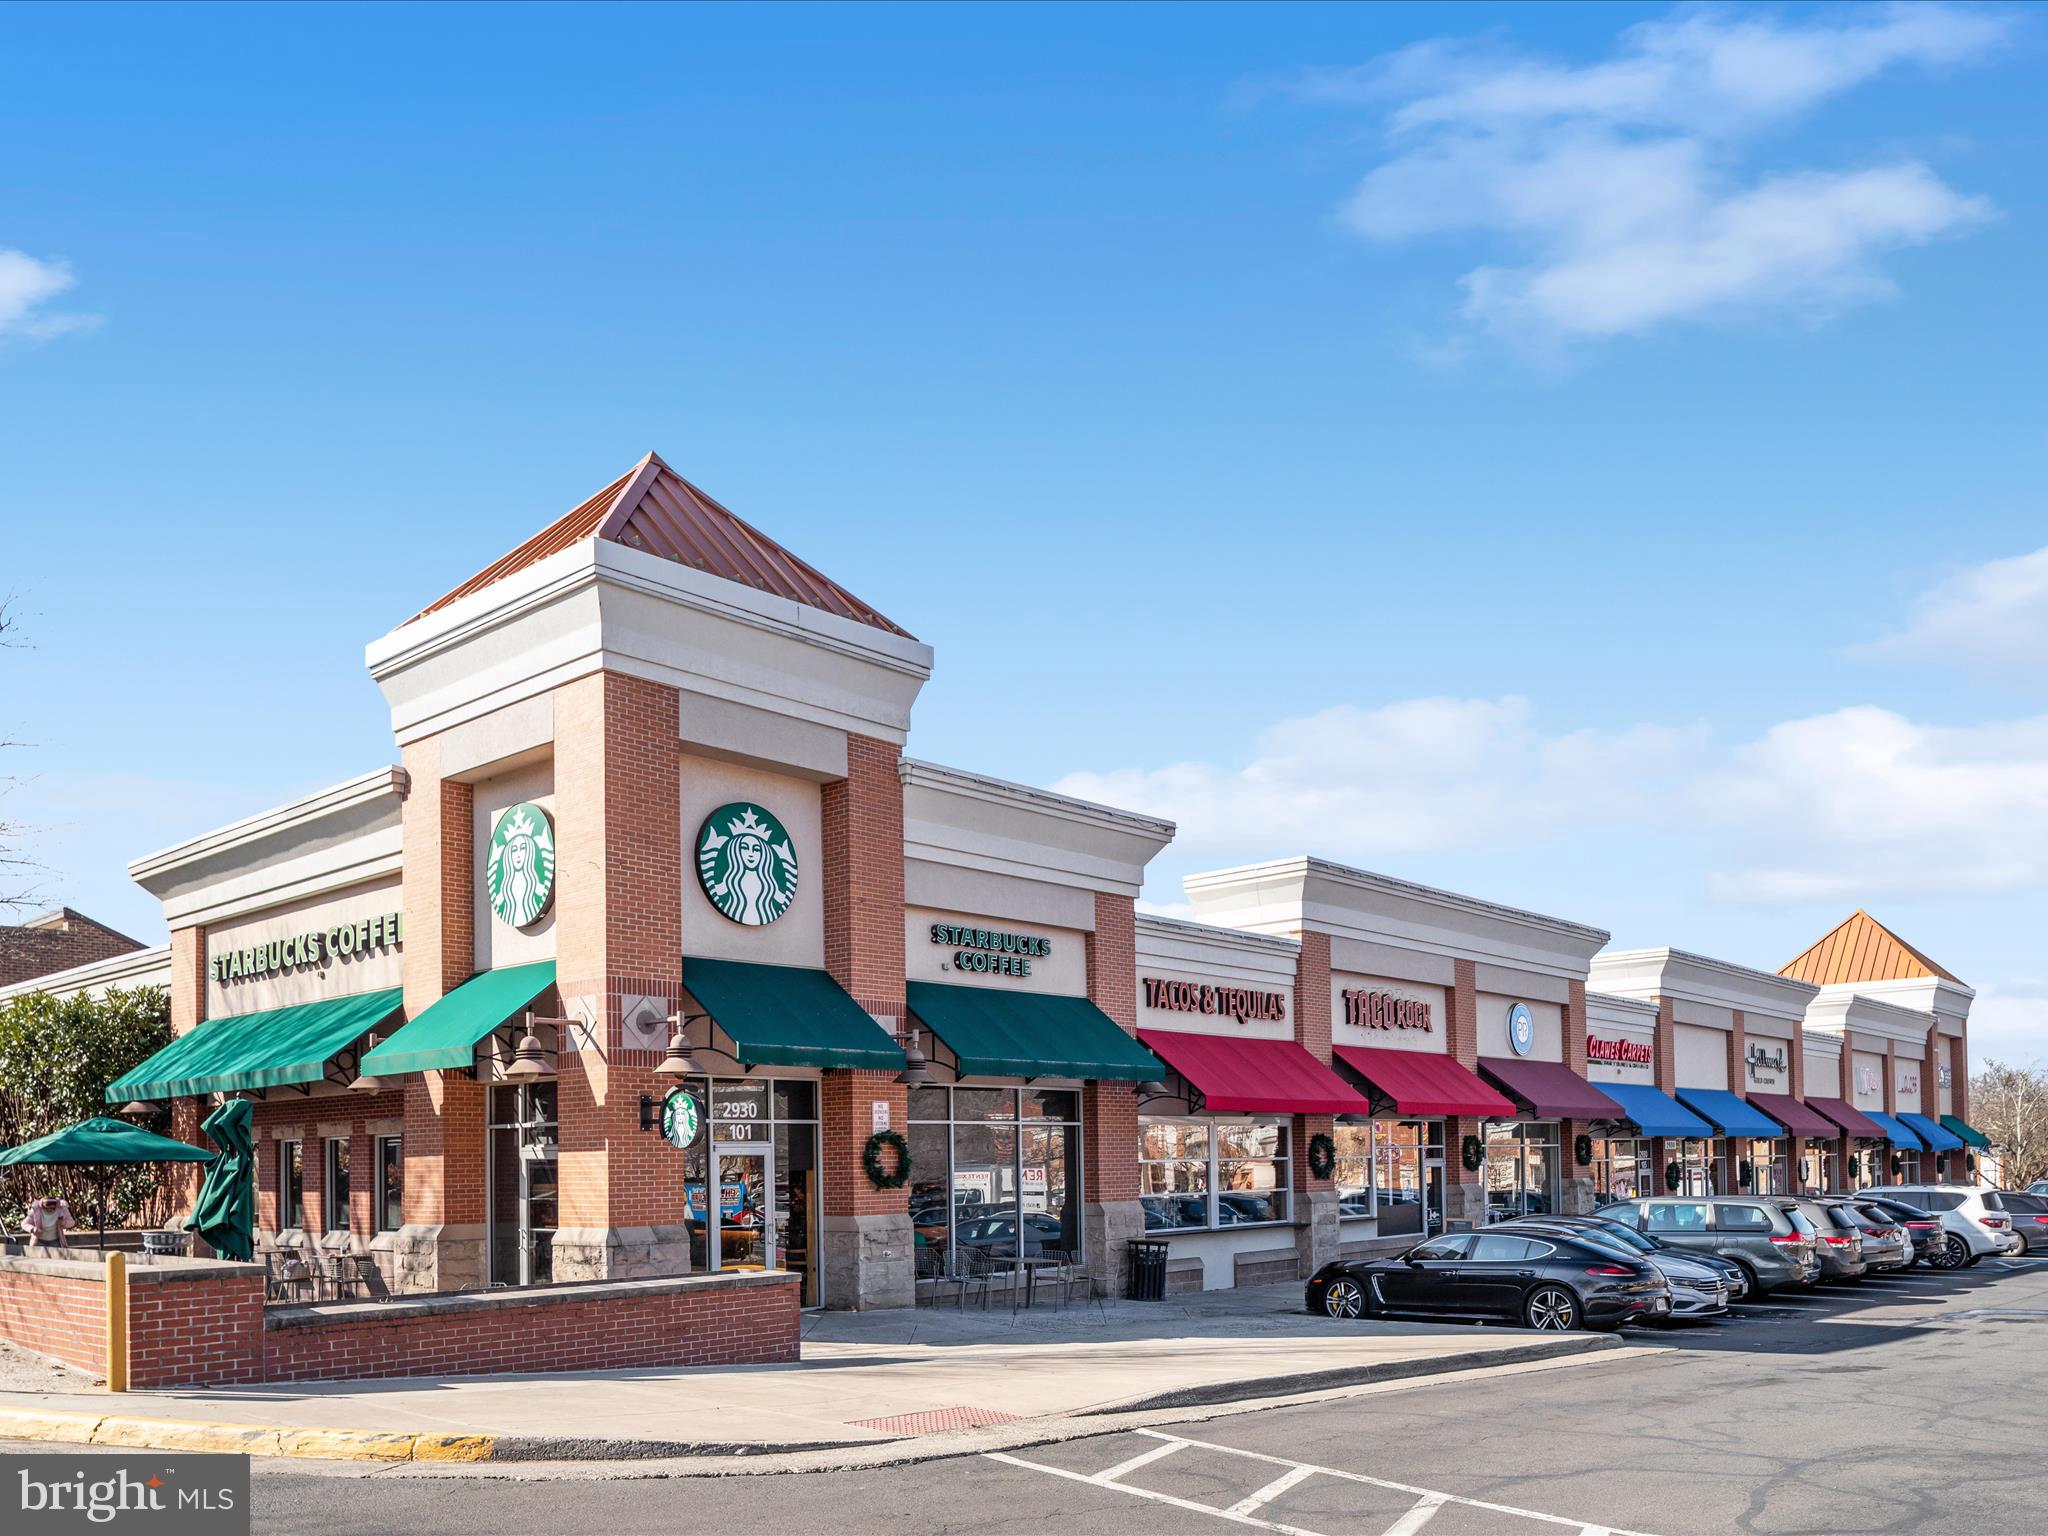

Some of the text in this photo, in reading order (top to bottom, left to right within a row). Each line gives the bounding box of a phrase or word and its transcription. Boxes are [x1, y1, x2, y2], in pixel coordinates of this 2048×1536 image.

[931, 923, 1052, 957] STARBUCKS
[209, 930, 319, 982] STARBUCKS
[954, 950, 1032, 977] COFFEE
[1143, 977, 1286, 1024] TACOS & TEQUILAS
[1342, 987, 1433, 1032] TACO ROCK
[1619, 1039, 1652, 1063] CARPETS
[722, 1101, 758, 1119] 2930
[729, 1124, 752, 1140] 101
